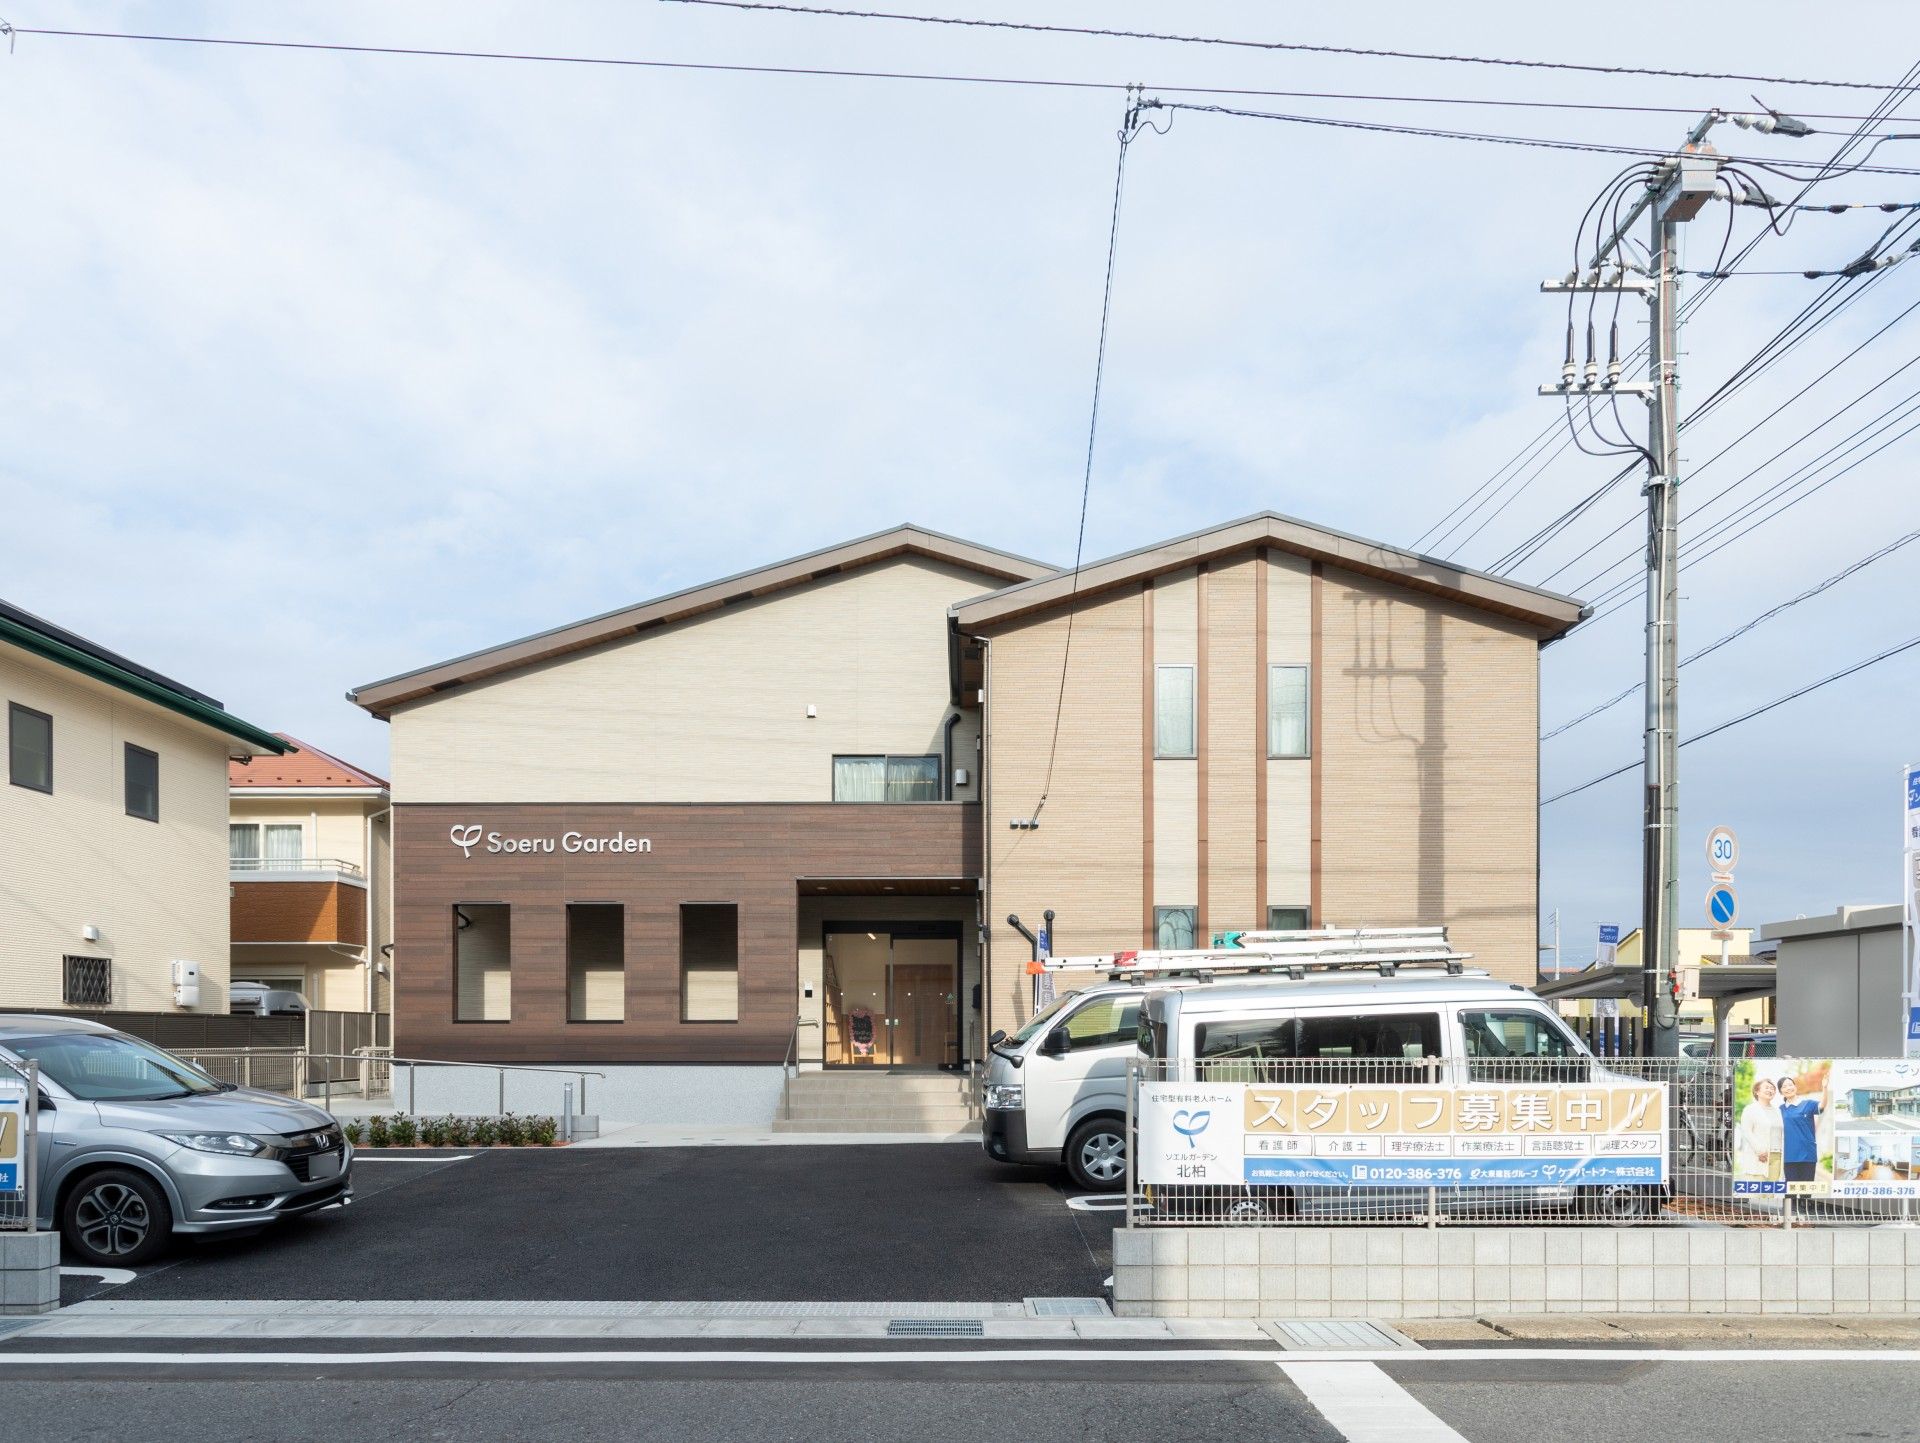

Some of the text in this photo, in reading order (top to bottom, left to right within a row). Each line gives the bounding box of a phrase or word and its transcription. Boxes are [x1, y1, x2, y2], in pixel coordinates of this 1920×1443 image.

[487, 831, 651, 854] Soeru Garden
[1714, 839, 1732, 859] 30
[1151, 1094, 1232, 1103] 住宅型有料老人ホーム
[1259, 1140, 1298, 1151] 看護師
[1328, 1141, 1368, 1152] 介護士
[1391, 1141, 1445, 1152] 理学療法士
[1461, 1141, 1515, 1152] 作業療法士
[1532, 1140, 1585, 1151] 言語聴覚士
[1176, 1164, 1207, 1178] 北柏
[1369, 1167, 1462, 1180] 0120-386-376
[1844, 1186, 1915, 1196] 0120-386-376
